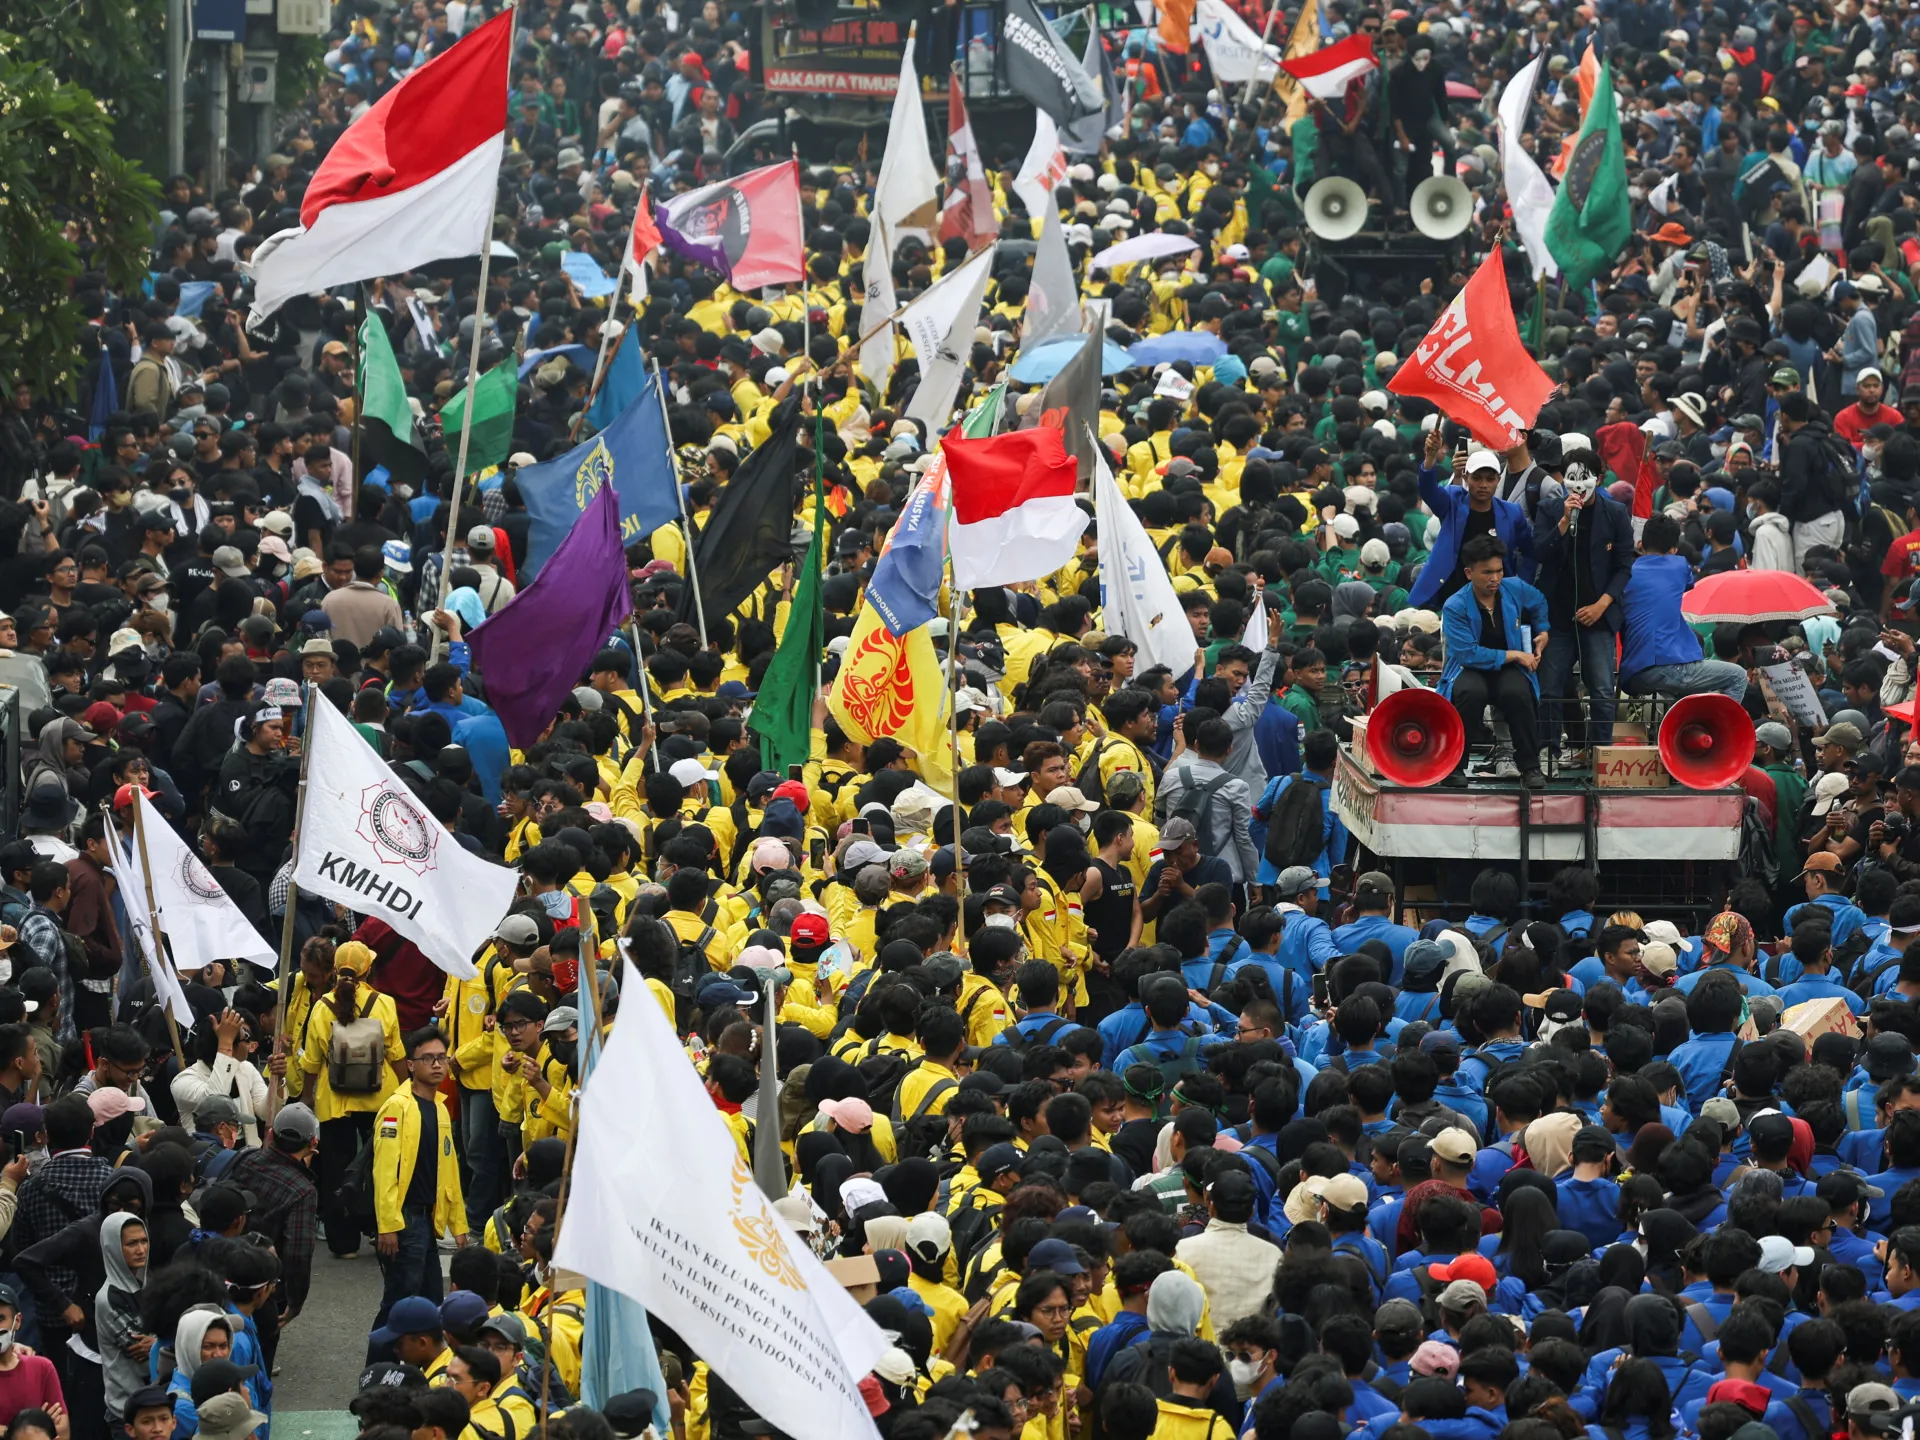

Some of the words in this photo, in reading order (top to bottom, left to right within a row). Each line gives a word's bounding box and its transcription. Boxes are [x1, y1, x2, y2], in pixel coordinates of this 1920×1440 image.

[769, 71, 846, 89] JAKARTA
[848, 75, 899, 91] TIMUR
[907, 474, 935, 532] MAHASISWA
[870, 589, 902, 631] INDONESIA
[1785, 683, 1806, 693] PAPUA
[1610, 759, 1659, 777] AYYA
[317, 851, 423, 921] KMHDI
[630, 1225, 684, 1272] AKULTAS
[686, 1266, 723, 1296] ILMU
[723, 1293, 822, 1370] PENGETAHUAN
[649, 1217, 702, 1256] IKATAN
[703, 1252, 776, 1308] KELUARGA
[779, 1304, 845, 1376] MAHASISWA
[662, 1272, 747, 1339] UNIVERSITAS
[748, 1334, 824, 1392] INDONESIA
